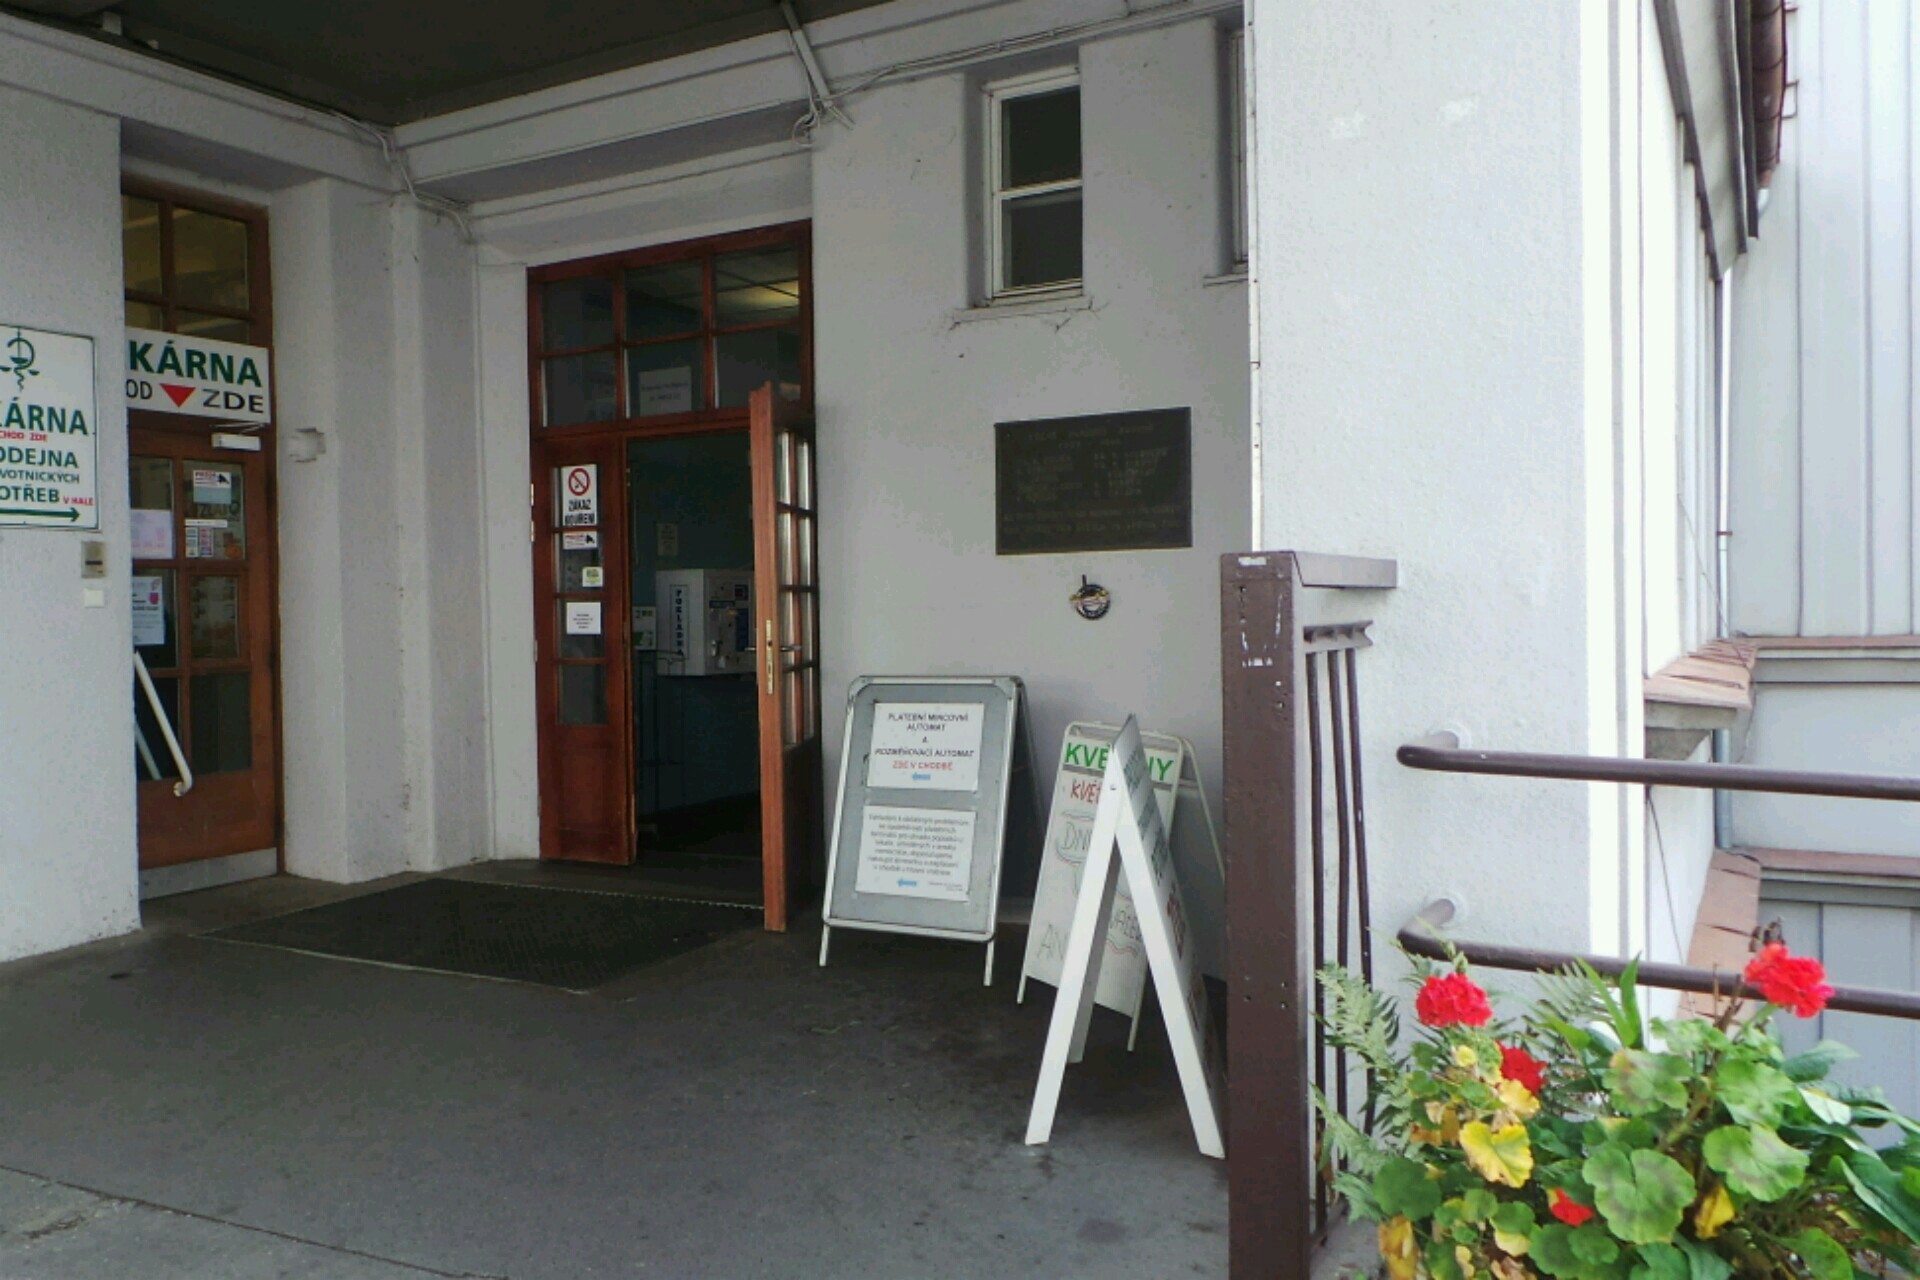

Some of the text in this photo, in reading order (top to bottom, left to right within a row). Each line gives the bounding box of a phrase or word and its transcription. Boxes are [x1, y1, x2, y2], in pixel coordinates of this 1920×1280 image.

[128, 339, 262, 388] KÁRNA
[0, 396, 89, 436] ÁRNA
[202, 388, 264, 414] ZDE
